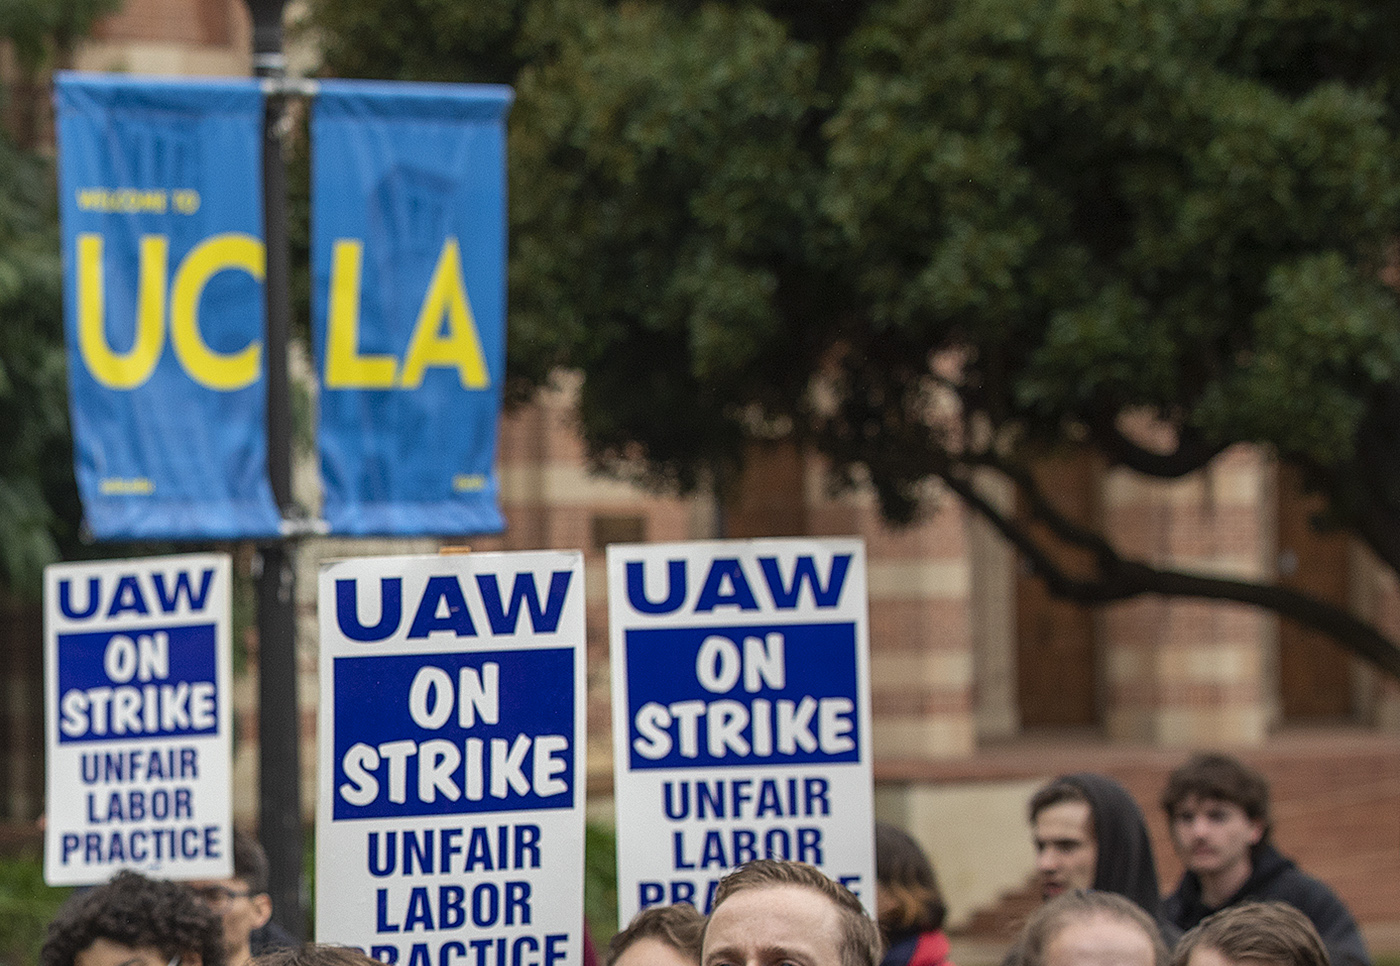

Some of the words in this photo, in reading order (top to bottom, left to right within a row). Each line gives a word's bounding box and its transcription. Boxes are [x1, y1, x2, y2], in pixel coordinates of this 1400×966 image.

[59, 569, 216, 621] UAW
[336, 571, 573, 642] UAW
[625, 554, 852, 615] UAW
[104, 631, 169, 683] ON
[695, 632, 785, 693] ON
[60, 680, 217, 738] STRIKE
[409, 662, 499, 729] ON
[633, 696, 855, 760] STRIKE
[81, 749, 199, 785] UNFAIR
[339, 733, 568, 806] STRIKE
[87, 788, 194, 825] LABOR
[662, 778, 831, 821] UNFAIR
[61, 826, 221, 866] PRACTICE
[367, 824, 541, 877] UNFAIR
[673, 828, 823, 870] LABOR
[376, 881, 531, 934] LABOR
